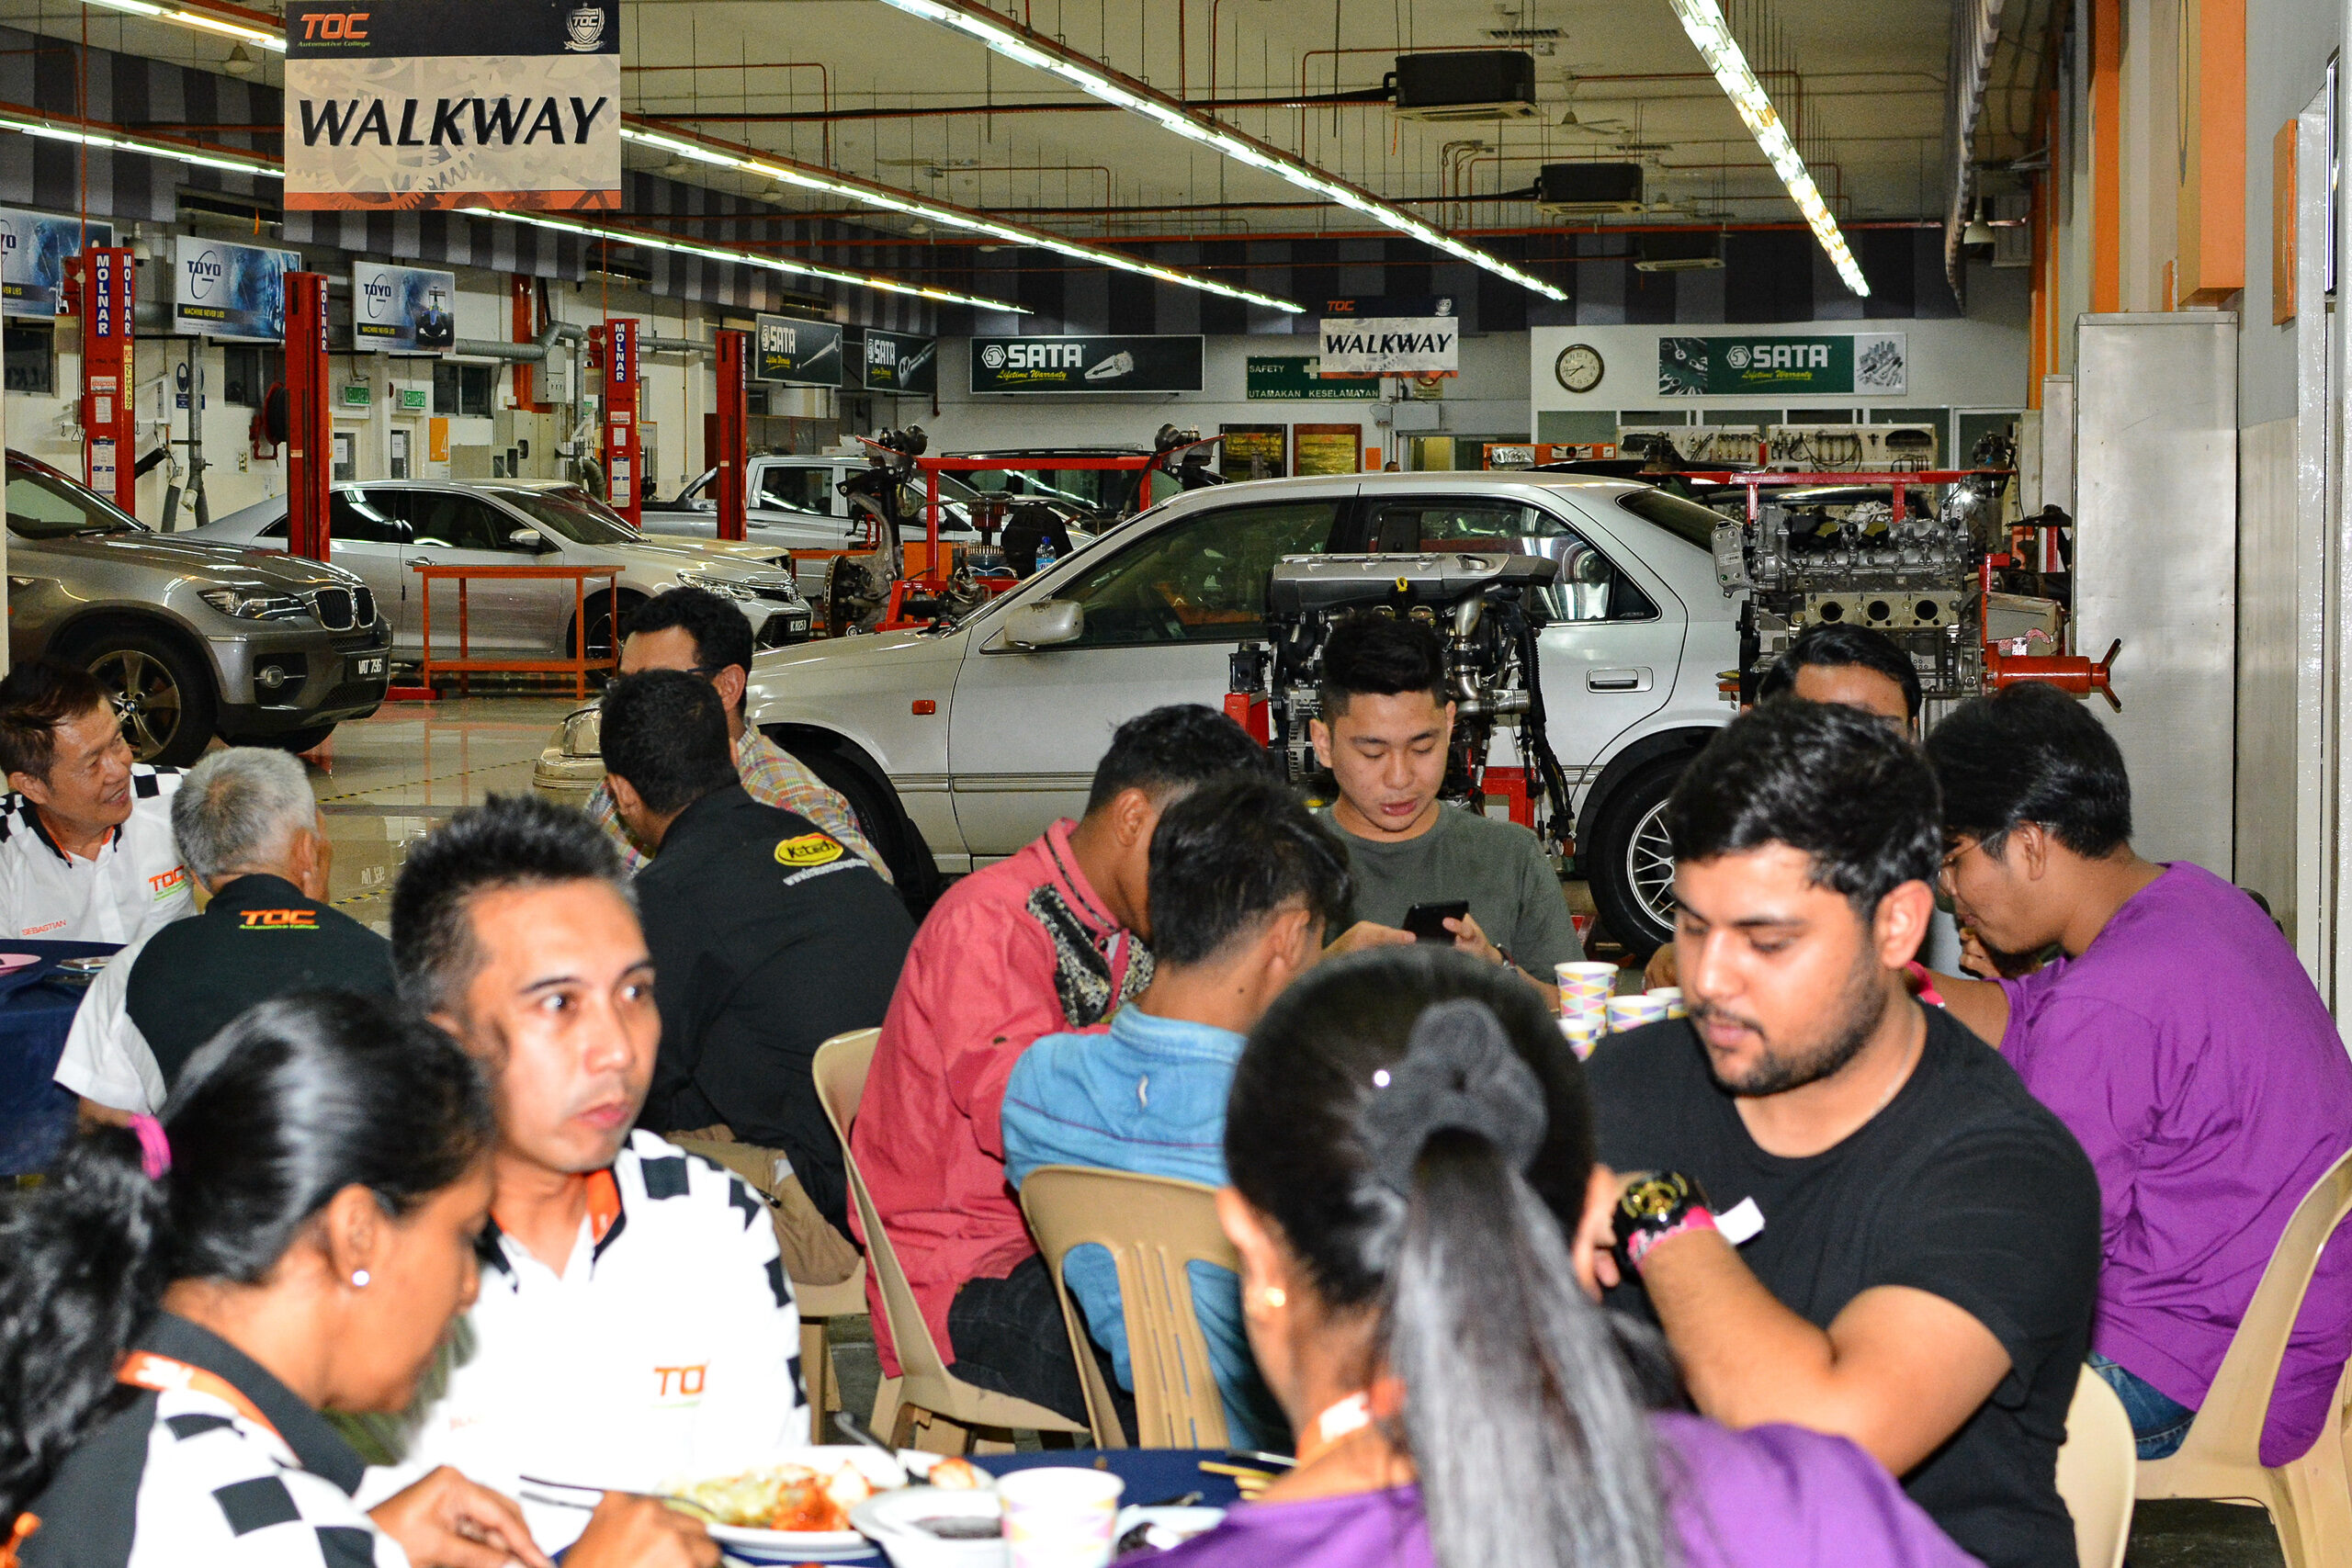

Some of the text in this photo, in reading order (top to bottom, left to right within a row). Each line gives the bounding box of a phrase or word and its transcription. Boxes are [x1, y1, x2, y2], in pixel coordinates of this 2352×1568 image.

[300, 13, 370, 39] TOC
[572, 16, 599, 27] TOC
[300, 96, 609, 146] WALKWAY
[187, 260, 221, 276] TOYO
[96, 254, 110, 334] MOLNAR
[123, 254, 131, 334] MOLNAR
[364, 283, 391, 297] TOYO
[184, 307, 203, 316] MACHINE
[1327, 300, 1356, 312] TOC
[770, 325, 796, 355] SATA
[1326, 333, 1453, 354] WALKWAY
[615, 323, 625, 381] MOLNAR
[874, 339, 896, 367] SATA
[1008, 344, 1083, 368] SATA
[1753, 344, 1828, 368] SATA
[996, 368, 1067, 380] Lifetime Warranty
[1249, 365, 1285, 374] SAFETY
[1742, 369, 1813, 380] Lifetime Warranty
[1249, 389, 1379, 398] UTAMAKAN KESELAMATAN
[440, 433, 448, 459] 4
[358, 658, 382, 674] VAT 796
[148, 865, 185, 892] TOC
[240, 908, 316, 925] TOC
[21, 919, 66, 936] SEBASTIAN
[654, 1365, 707, 1397] TO
